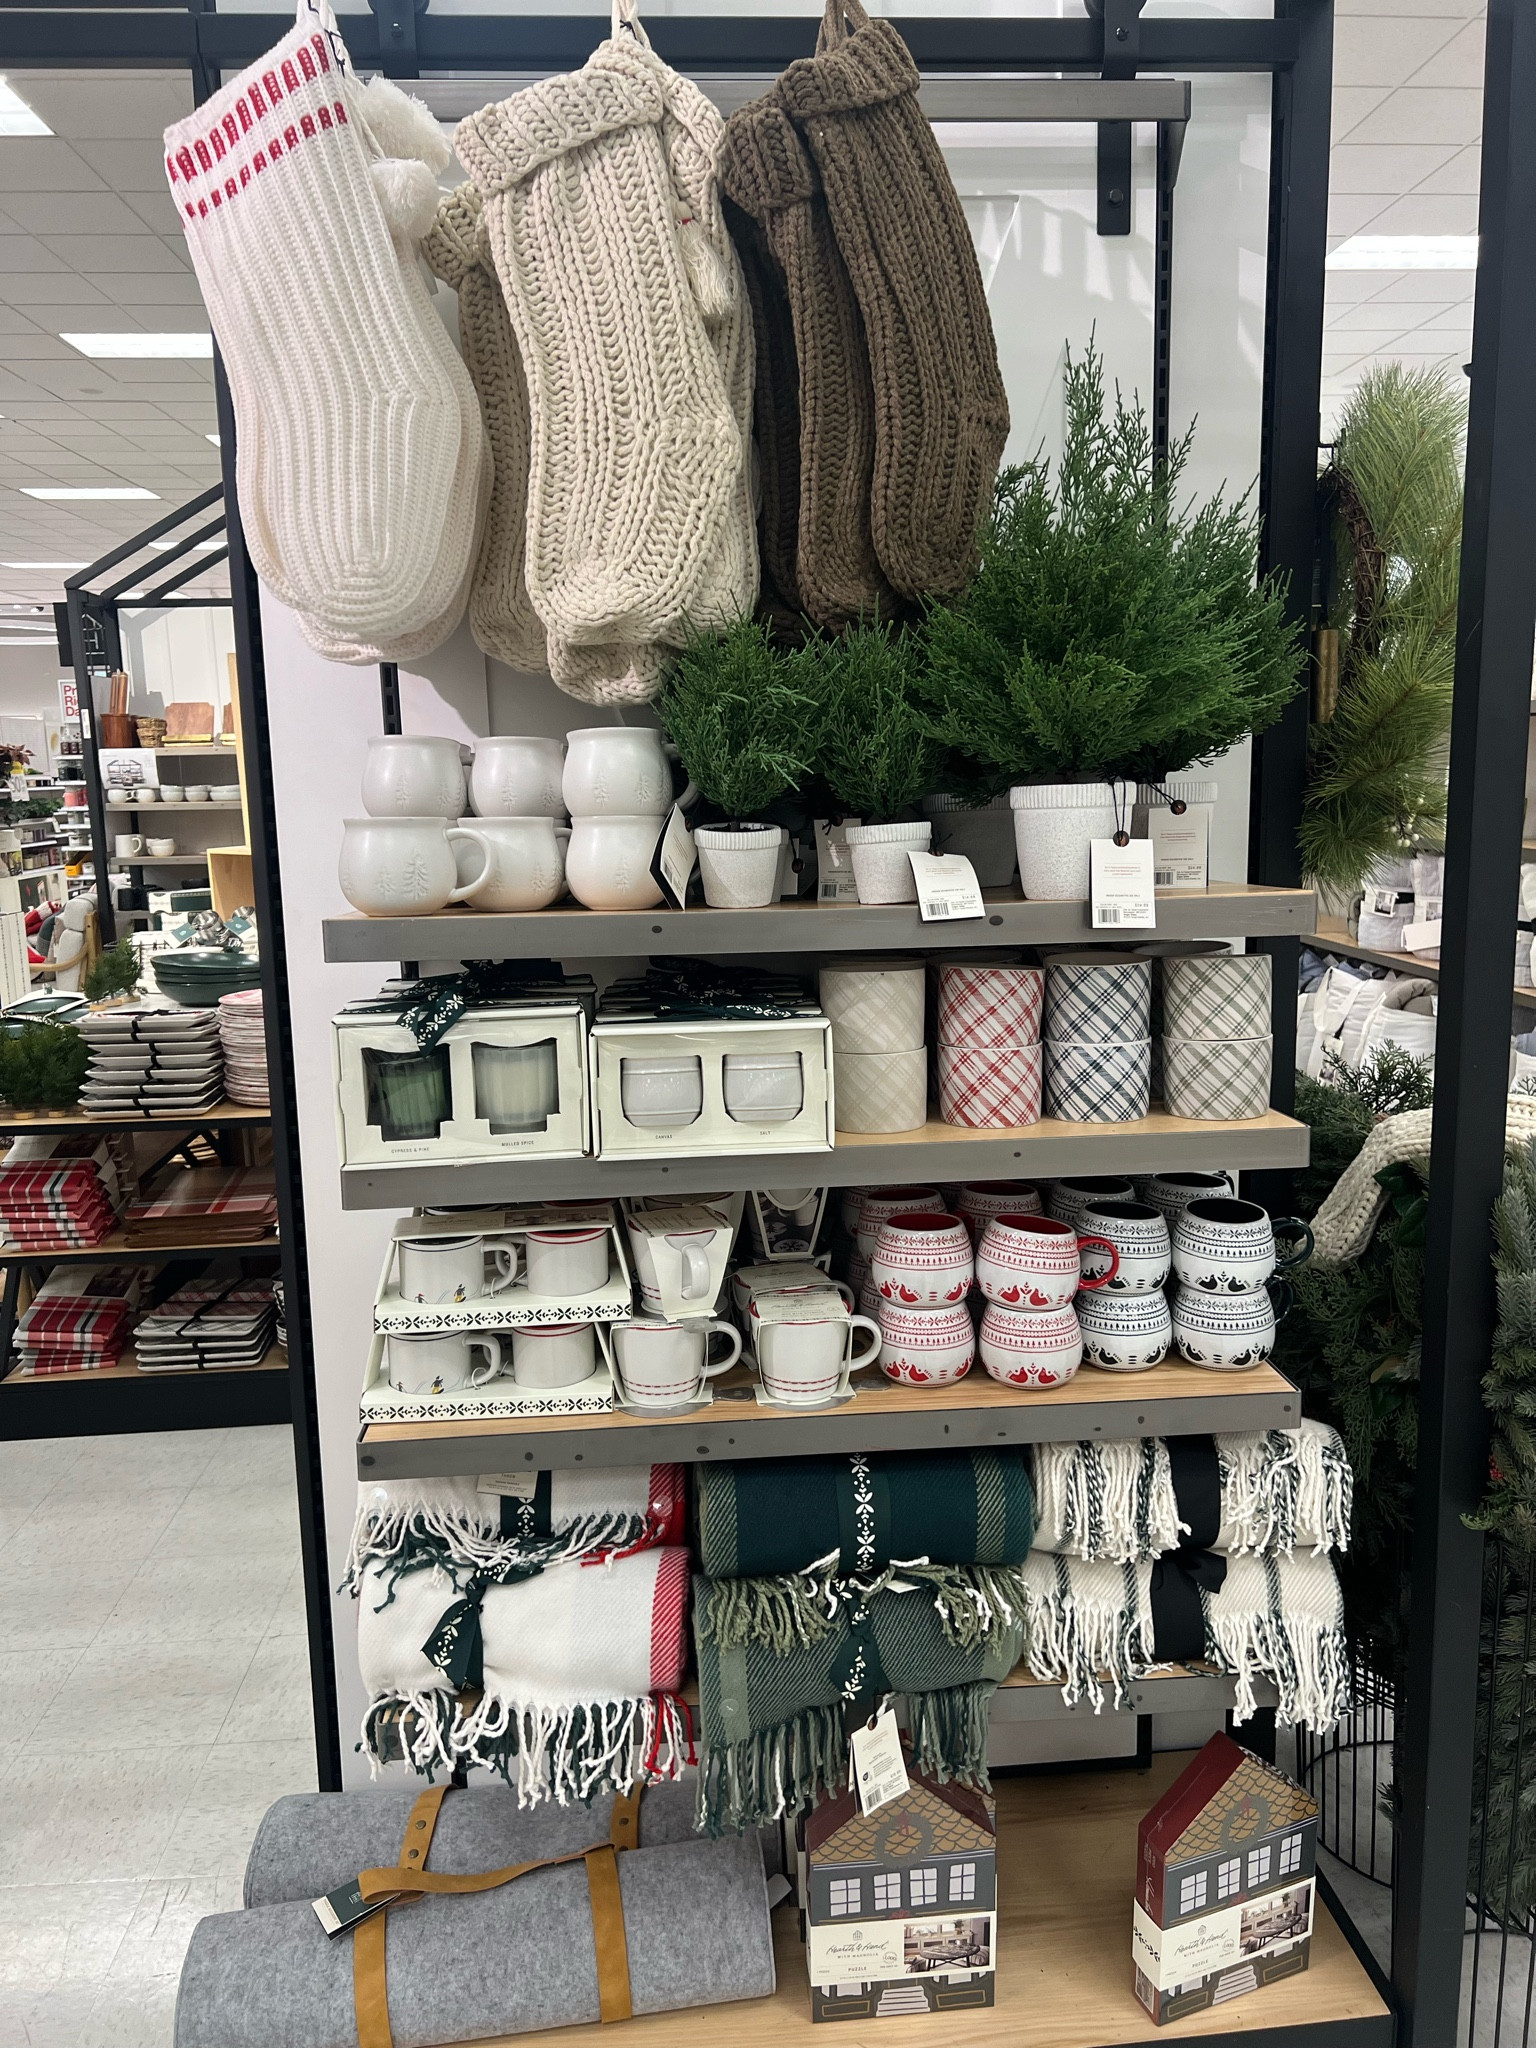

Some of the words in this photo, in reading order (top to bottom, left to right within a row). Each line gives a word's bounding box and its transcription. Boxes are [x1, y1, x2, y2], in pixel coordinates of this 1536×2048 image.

[64, 685, 77, 695] Pr
[64, 696, 78, 705] Ri
[66, 707, 80, 716] Da
[826, 1942, 858, 1955] Hearth
[862, 1940, 890, 1952] Hand
